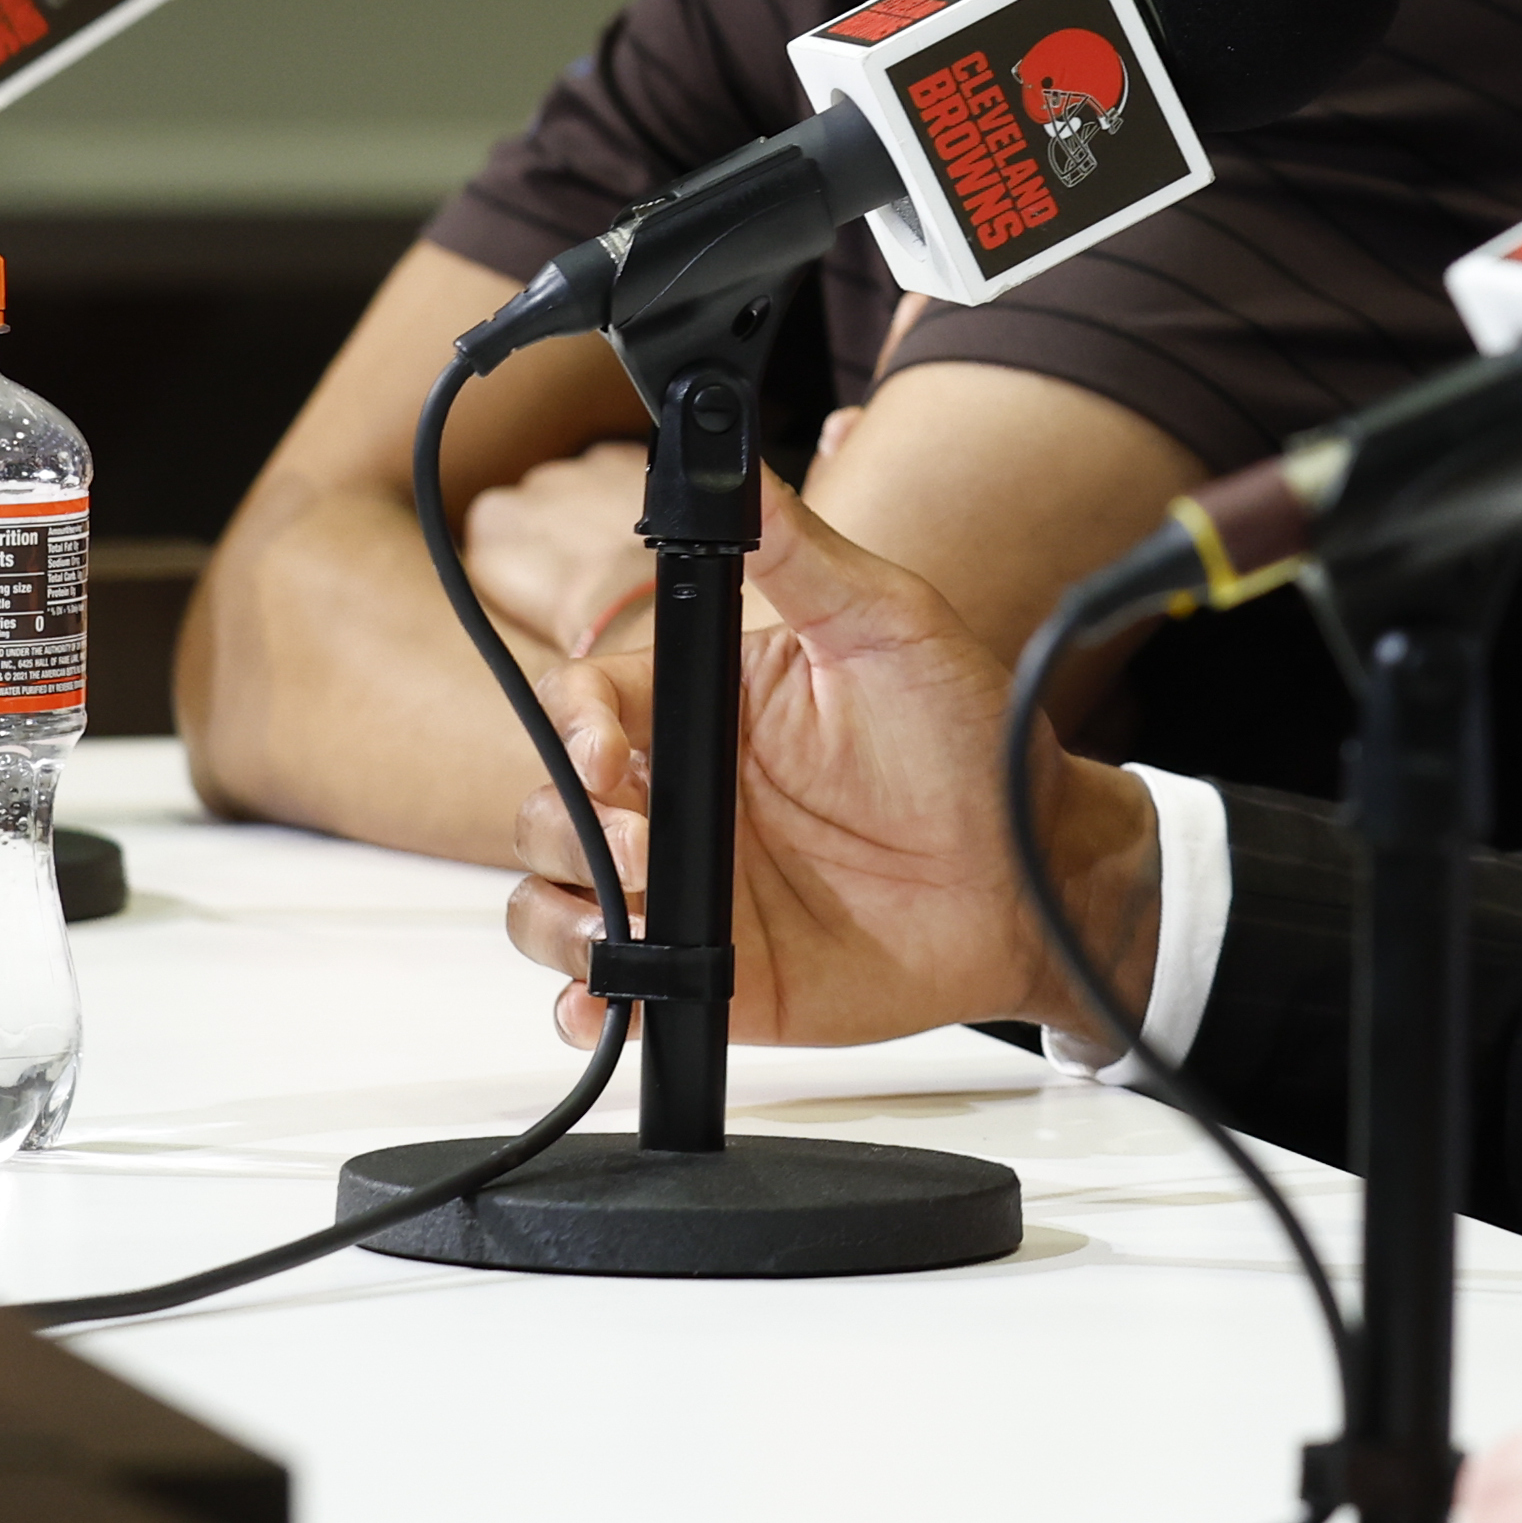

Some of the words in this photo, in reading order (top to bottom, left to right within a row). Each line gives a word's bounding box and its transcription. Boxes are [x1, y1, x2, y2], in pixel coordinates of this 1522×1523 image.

[951, 50, 1060, 230] CLEVELAND
[907, 67, 1025, 251] BROWNS
[12, 582, 32, 594] size
[36, 616, 44, 632] 0
[5, 647, 30, 658] UNDER
[32, 647, 42, 656] THE
[12, 672, 28, 682] 2021
